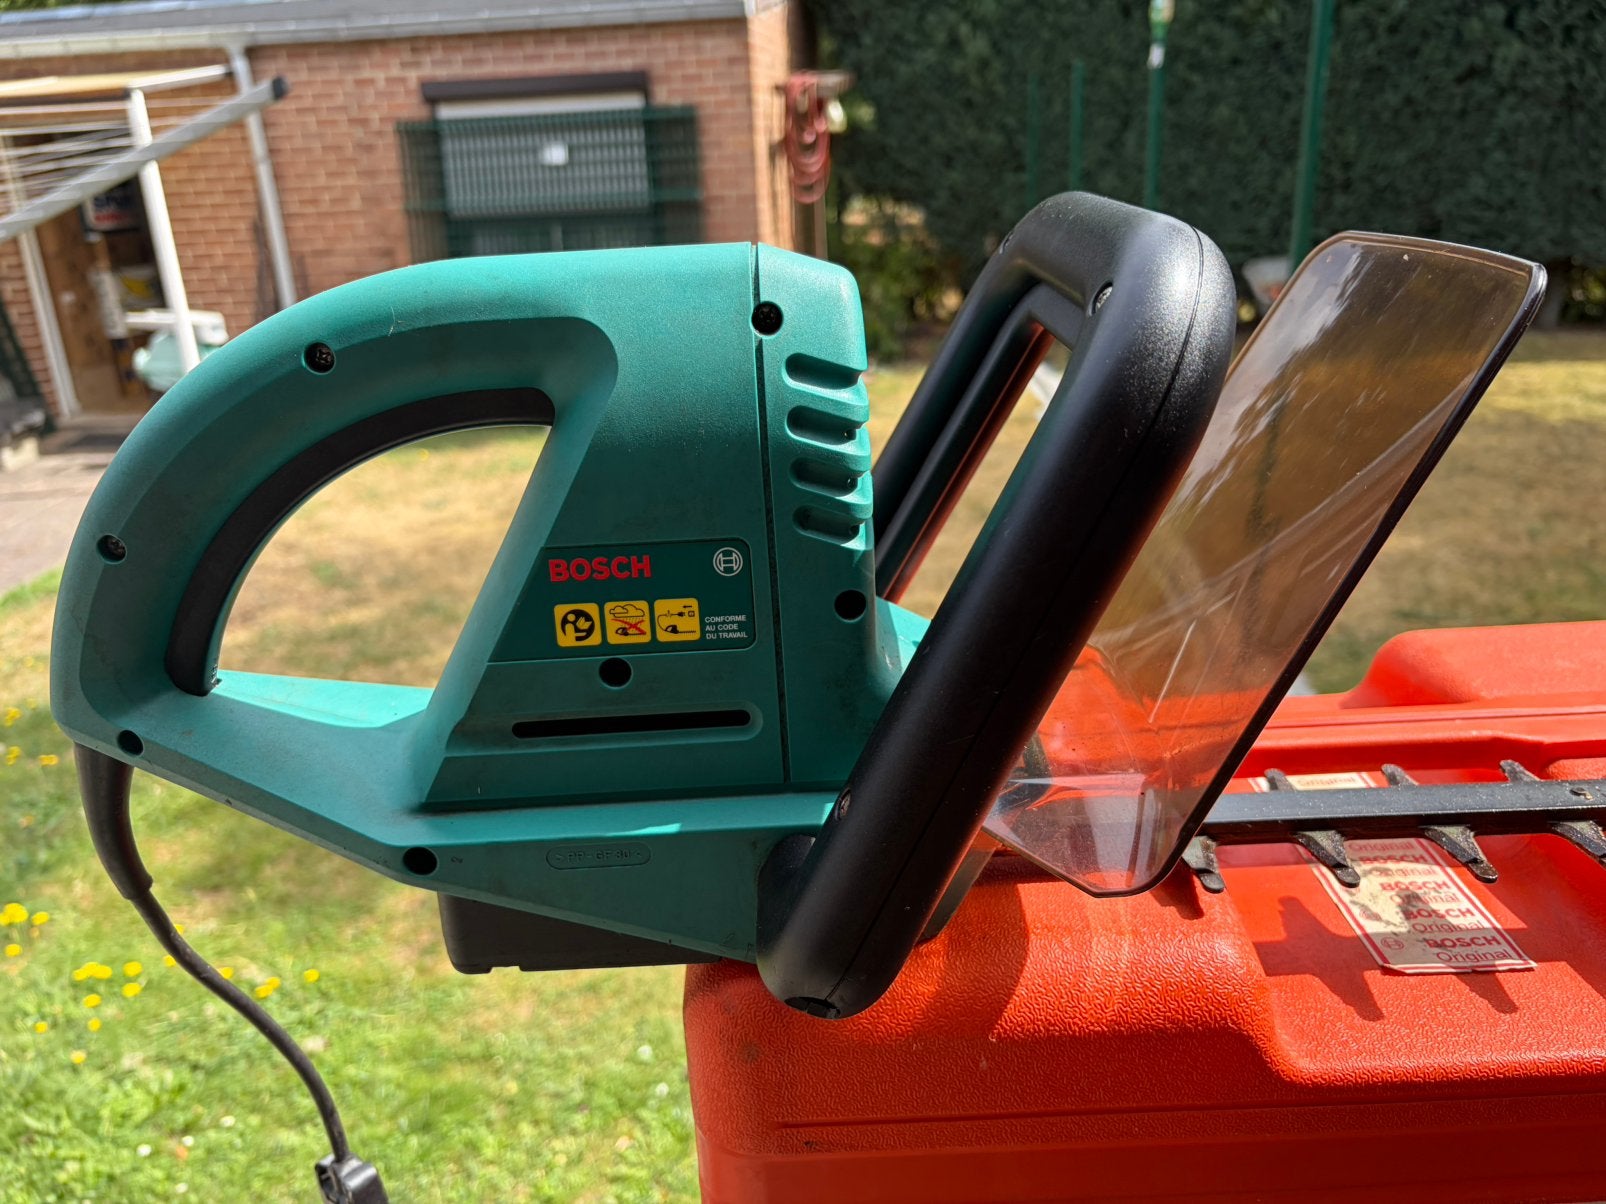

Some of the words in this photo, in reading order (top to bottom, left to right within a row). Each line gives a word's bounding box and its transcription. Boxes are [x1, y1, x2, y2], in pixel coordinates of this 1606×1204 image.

[549, 555, 651, 582] BOSCH
[705, 614, 747, 623] CONFORME
[717, 623, 739, 631] CODE
[719, 631, 748, 639] TRAVAIL
[1359, 854, 1429, 865] BOSCH
[1379, 880, 1452, 891] BOSCH
[1403, 907, 1475, 920] BOSCH
[1411, 919, 1485, 933] Original
[1425, 935, 1502, 949] BOSCH
[1436, 948, 1514, 963] Original
